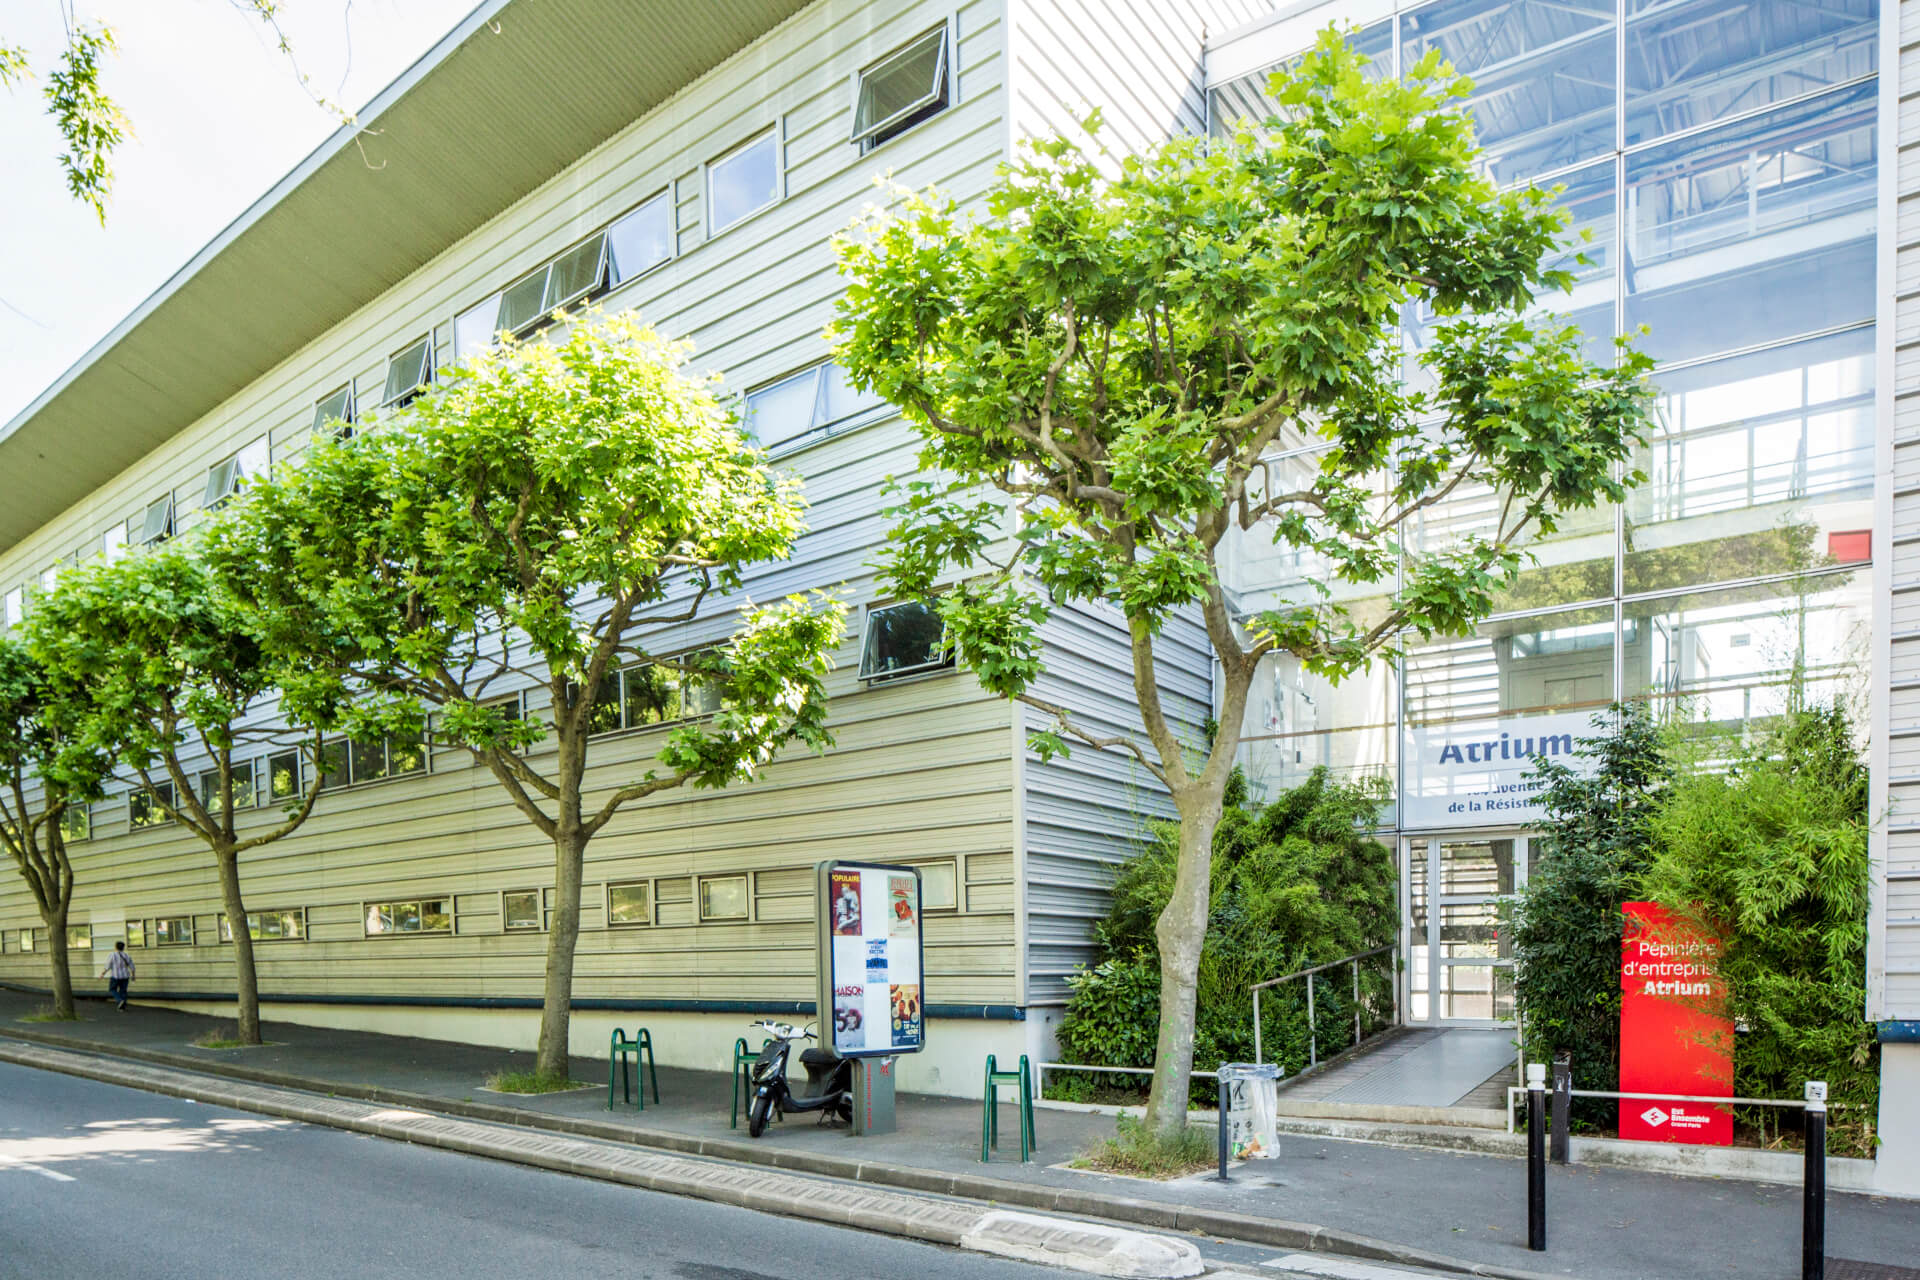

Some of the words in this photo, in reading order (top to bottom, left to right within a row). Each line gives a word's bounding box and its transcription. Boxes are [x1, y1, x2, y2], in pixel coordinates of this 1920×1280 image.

[1439, 732, 1573, 765] Atrium
[1448, 802, 1465, 813] de
[1469, 800, 1482, 812] la
[1643, 981, 1711, 996] Atrium
[1671, 1115, 1710, 1123] Ensemble
